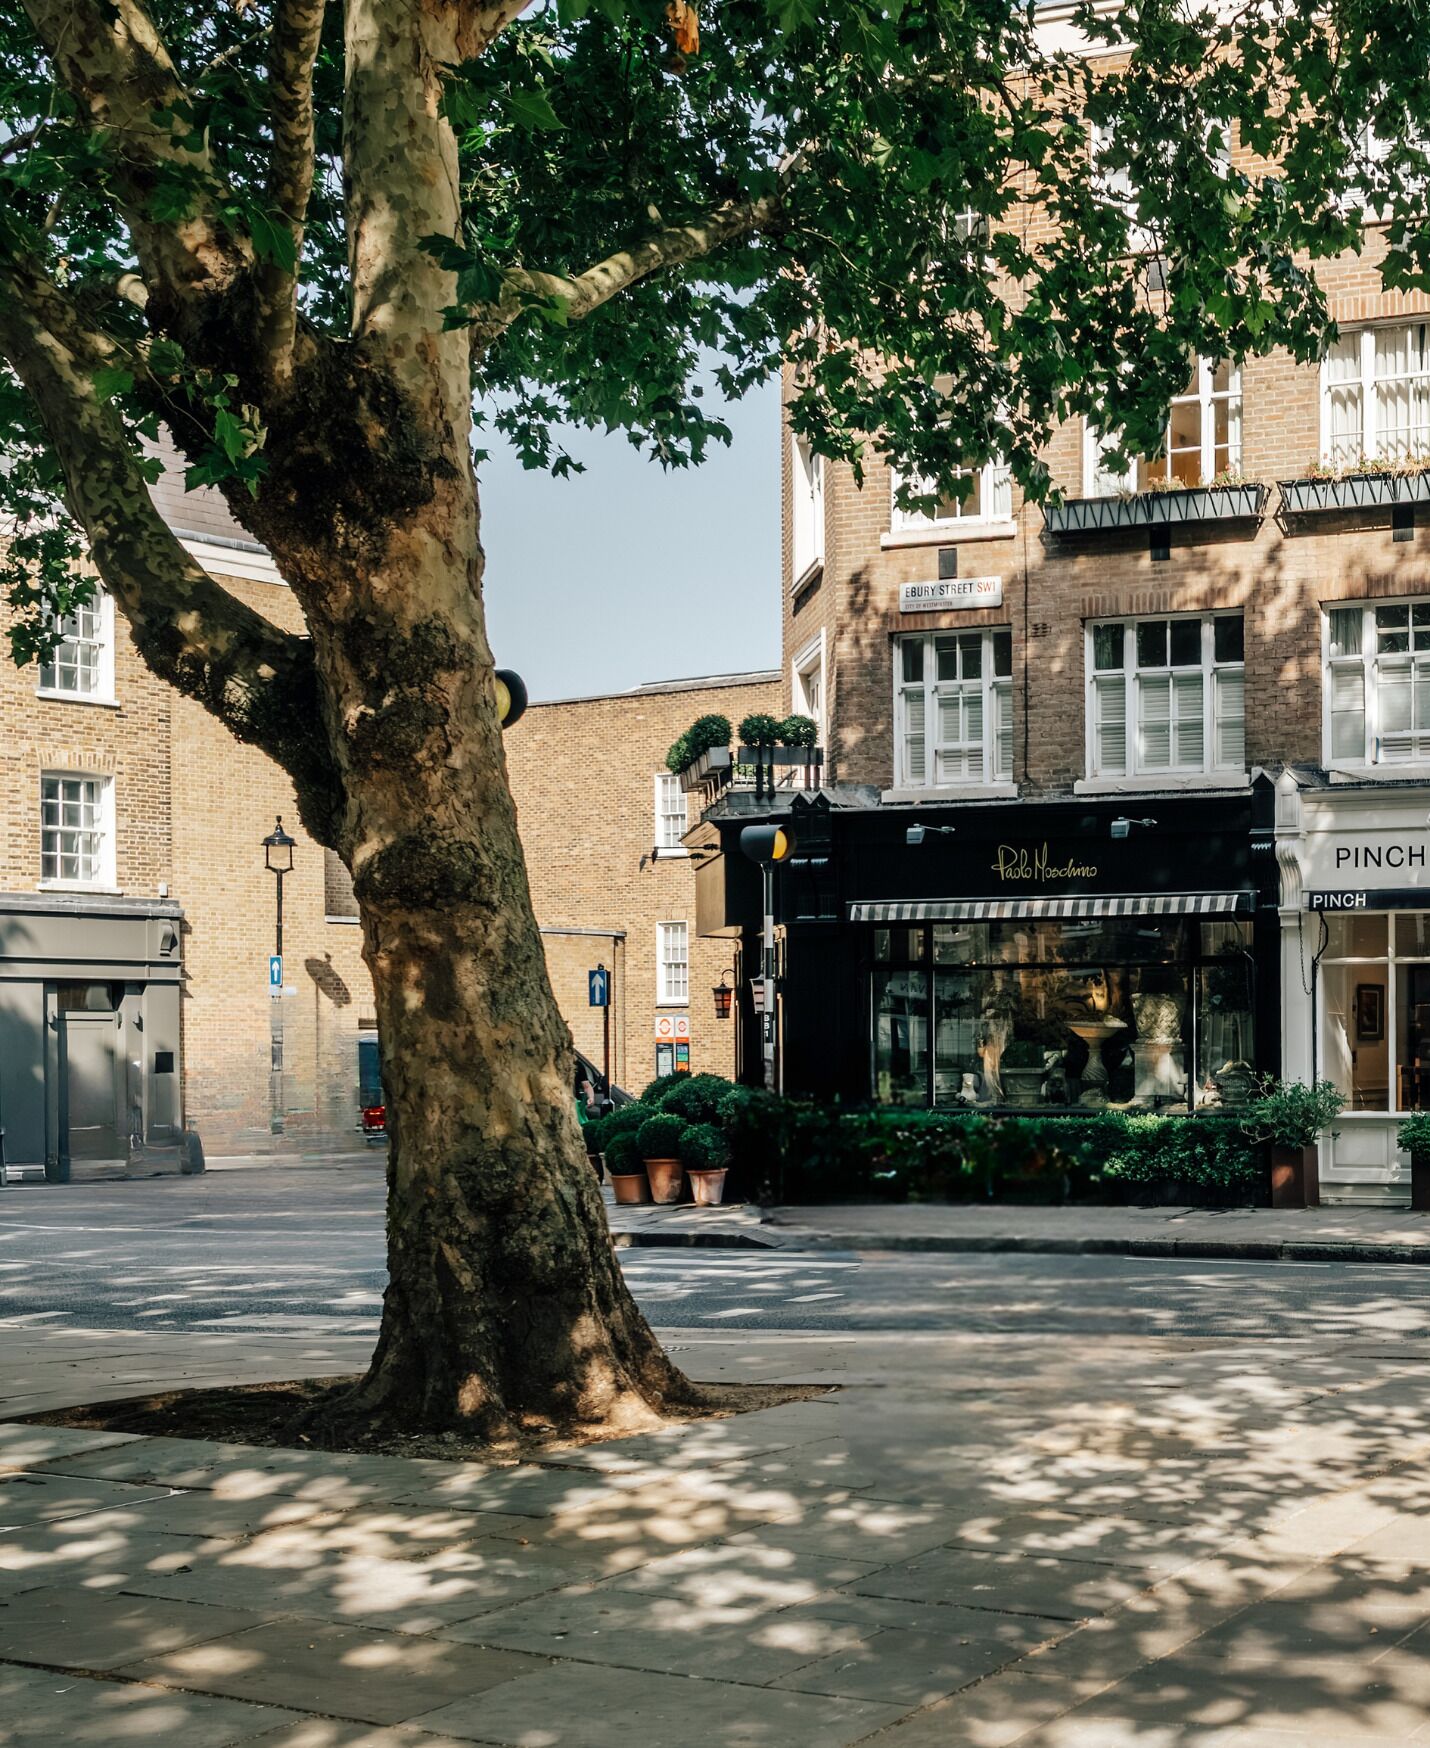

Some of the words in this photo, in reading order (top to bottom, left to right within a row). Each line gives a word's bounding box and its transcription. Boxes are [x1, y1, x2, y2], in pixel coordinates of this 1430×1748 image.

[905, 585, 936, 598] EBURY
[939, 582, 974, 596] STREET
[977, 581, 997, 593] SW1
[991, 844, 1033, 881] Paolo
[1336, 845, 1425, 869] PINCH
[1313, 893, 1367, 908] PINCH
